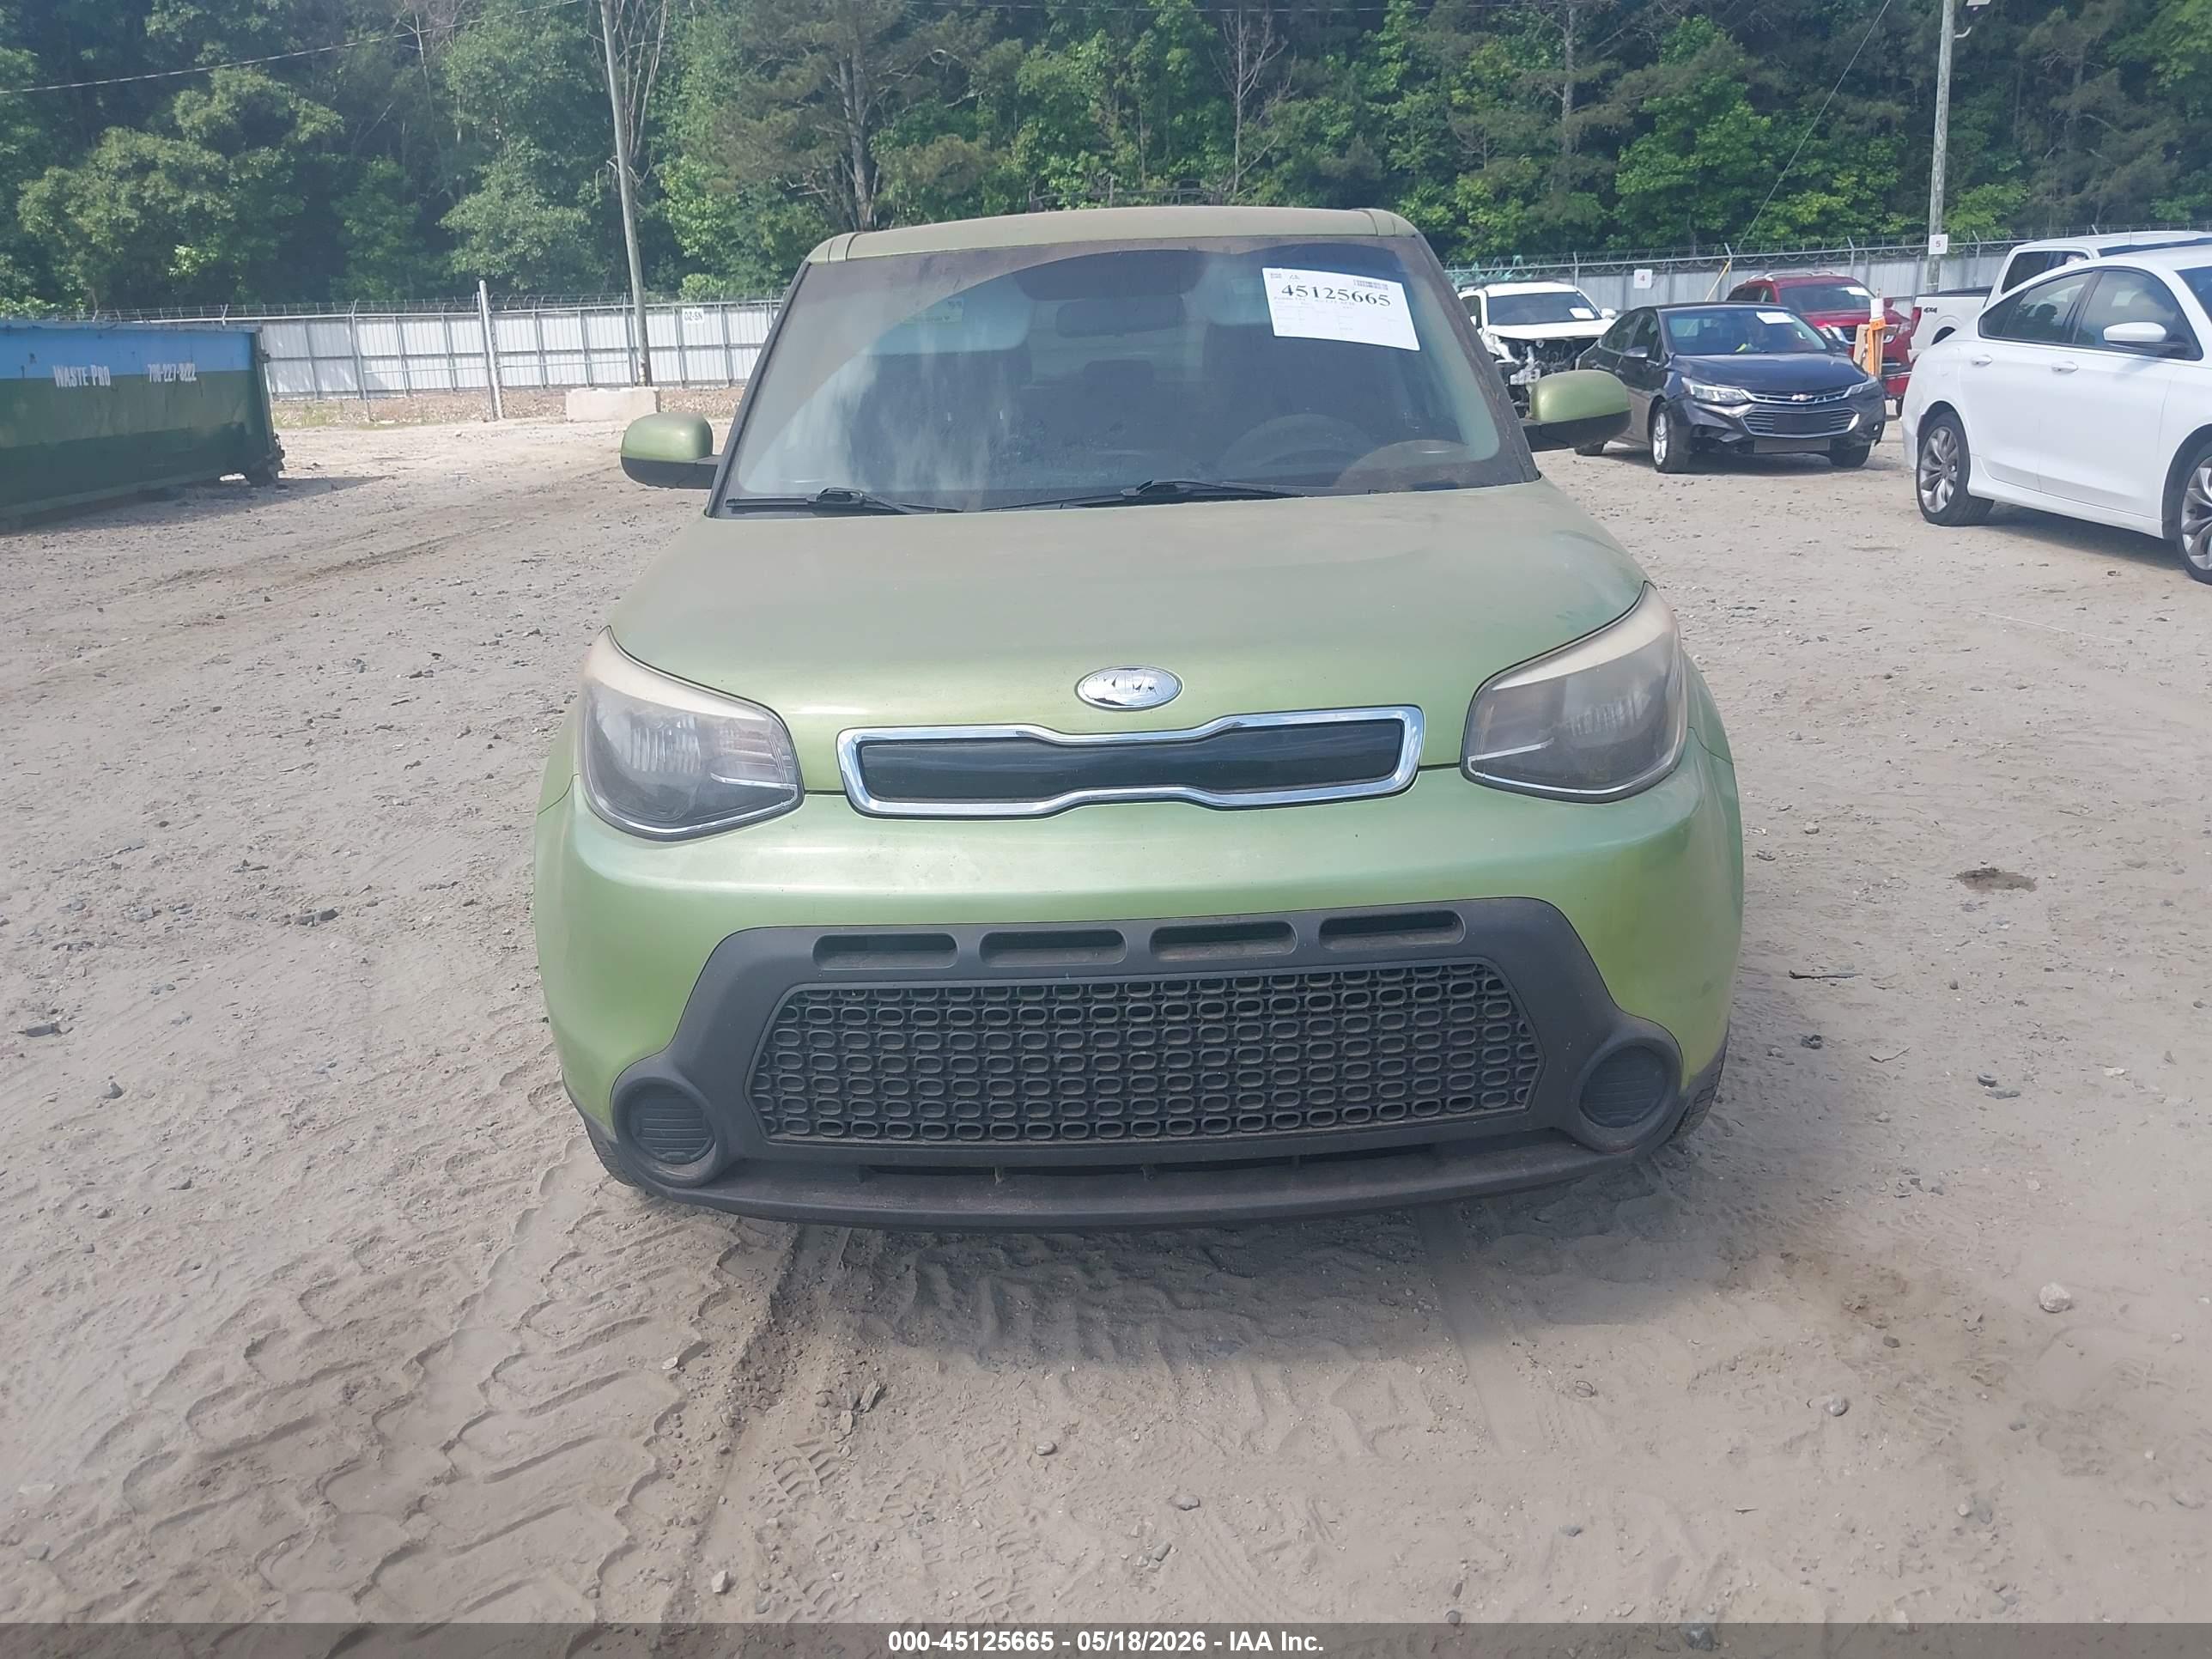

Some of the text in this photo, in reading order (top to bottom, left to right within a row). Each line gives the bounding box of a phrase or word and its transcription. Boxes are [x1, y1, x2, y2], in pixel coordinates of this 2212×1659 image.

[1936, 240, 1942, 248] 5
[1280, 283, 1392, 307] 45125665
[52, 364, 89, 388] WASTE
